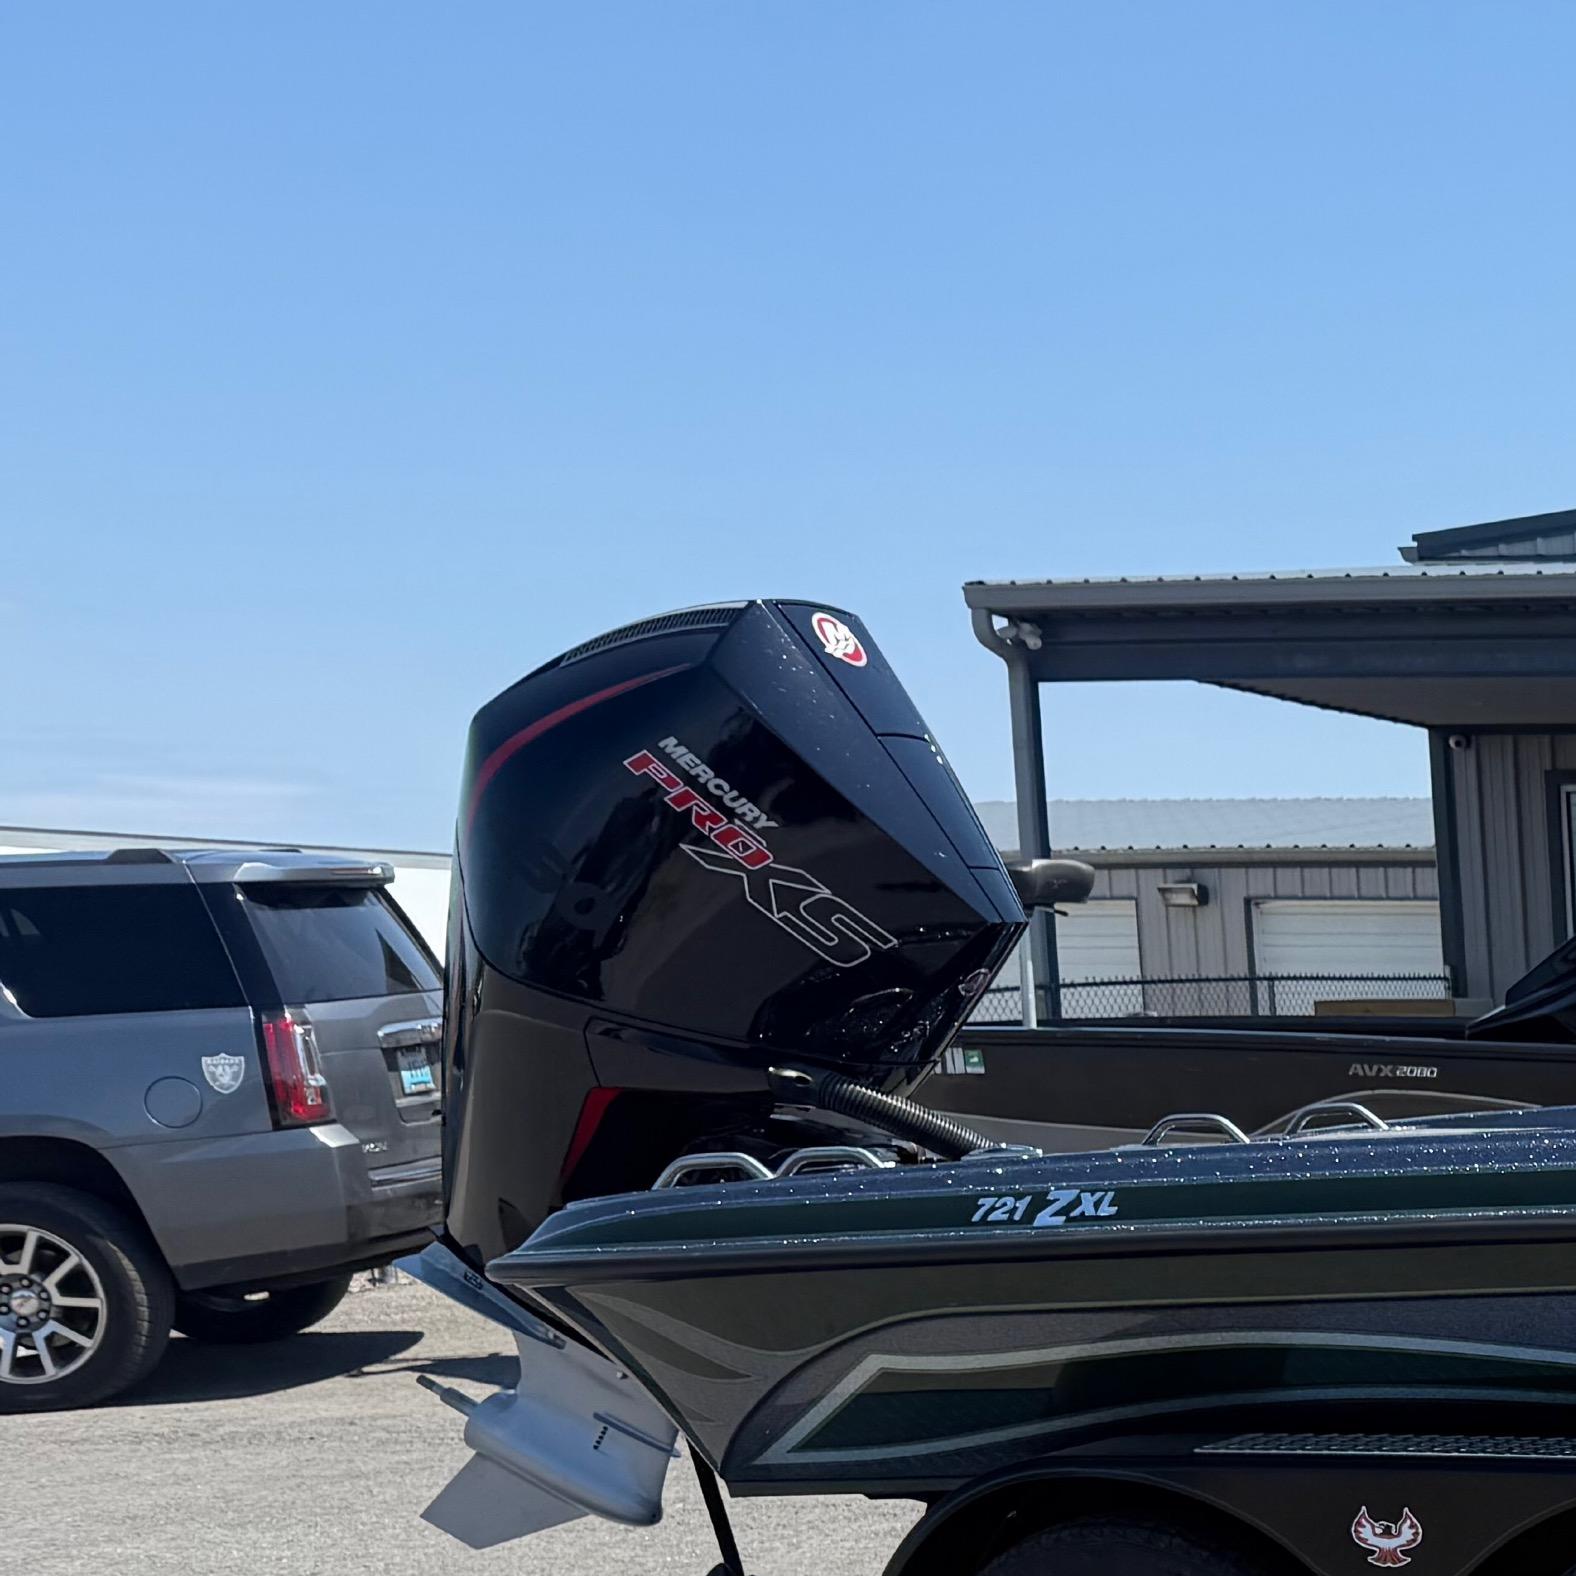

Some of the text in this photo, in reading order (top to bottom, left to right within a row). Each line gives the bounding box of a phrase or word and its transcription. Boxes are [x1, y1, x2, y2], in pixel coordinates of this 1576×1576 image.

[623, 749, 774, 870] PRO
[657, 736, 779, 828] MERCURY
[679, 818, 900, 967] XS
[1348, 1064, 1393, 1077] AVX
[971, 1195, 1033, 1223] 721
